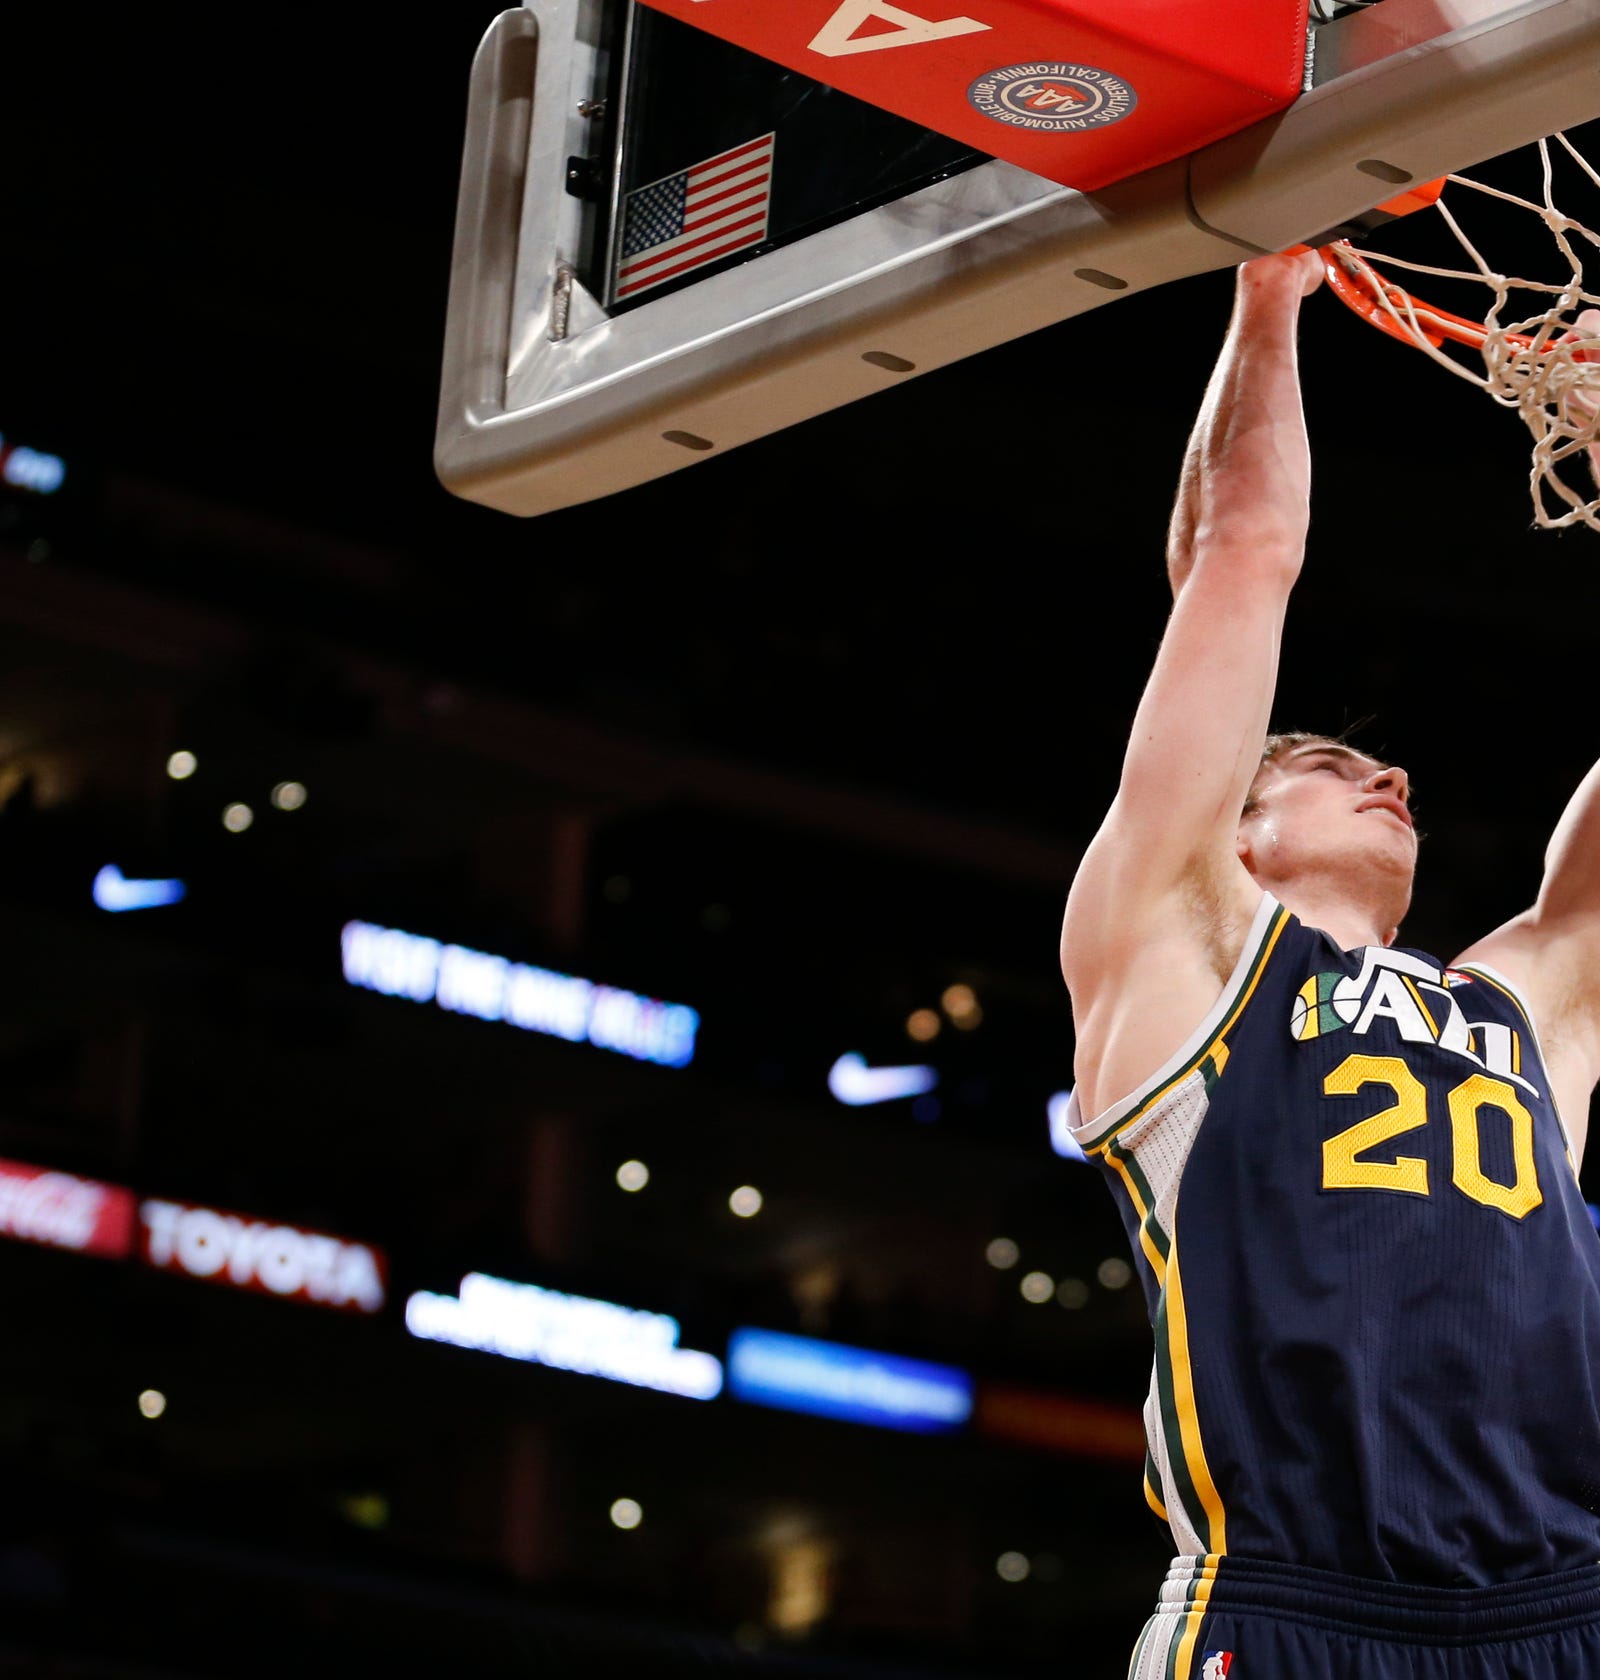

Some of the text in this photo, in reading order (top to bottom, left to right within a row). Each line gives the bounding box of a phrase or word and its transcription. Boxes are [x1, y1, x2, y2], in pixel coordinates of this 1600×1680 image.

[973, 82, 1087, 130] AUTOMOBILE CLUB
[993, 64, 1130, 122] SOUTHERN CALIFORNIA
[1016, 84, 1085, 113] AAA
[1320, 1053, 1544, 1220] 20
[141, 1199, 384, 1313] TOYOTA
